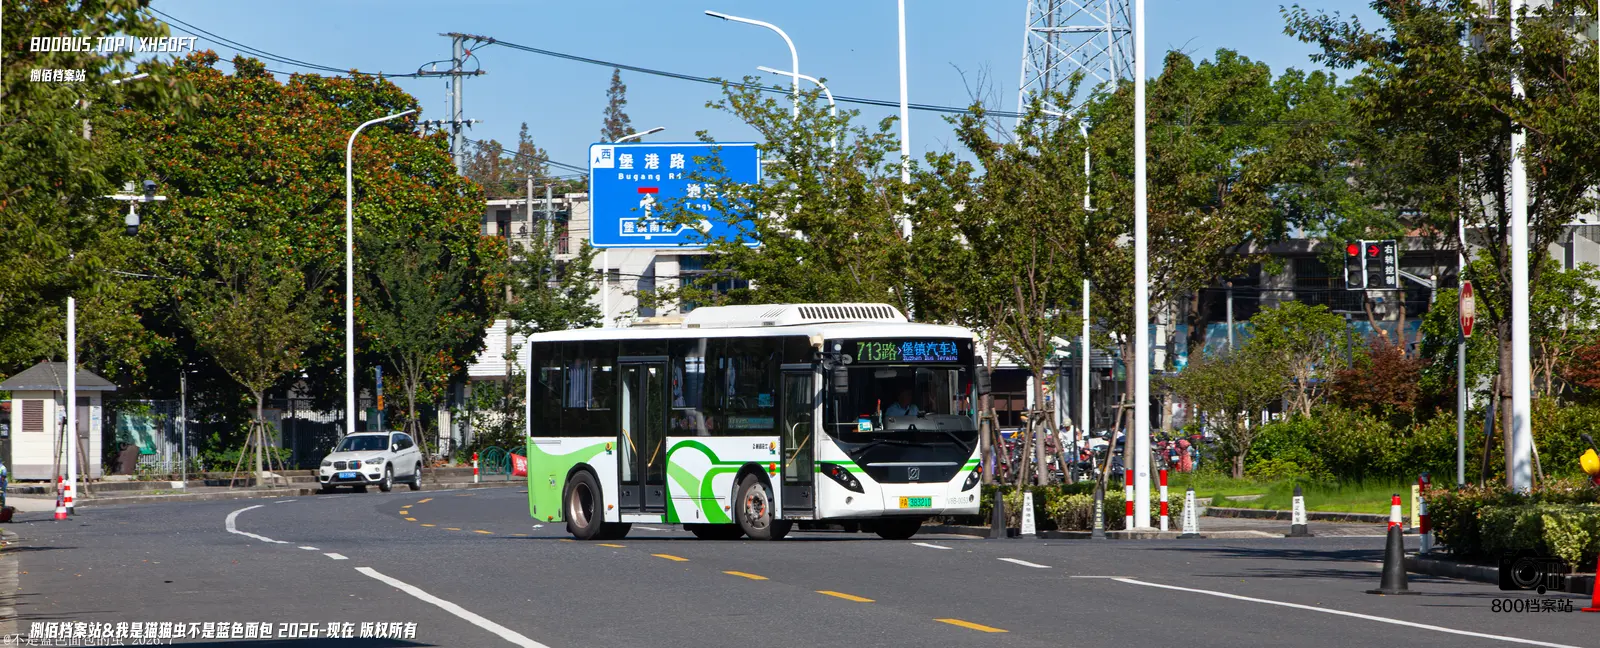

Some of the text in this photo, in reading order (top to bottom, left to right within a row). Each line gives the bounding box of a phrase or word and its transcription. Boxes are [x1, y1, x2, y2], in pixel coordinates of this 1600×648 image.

[600, 148, 612, 160] 西
[618, 153, 685, 170] 堡港路
[618, 173, 661, 182] Bugang
[1384, 245, 1395, 285] 右转控制
[856, 342, 897, 360] 713路
